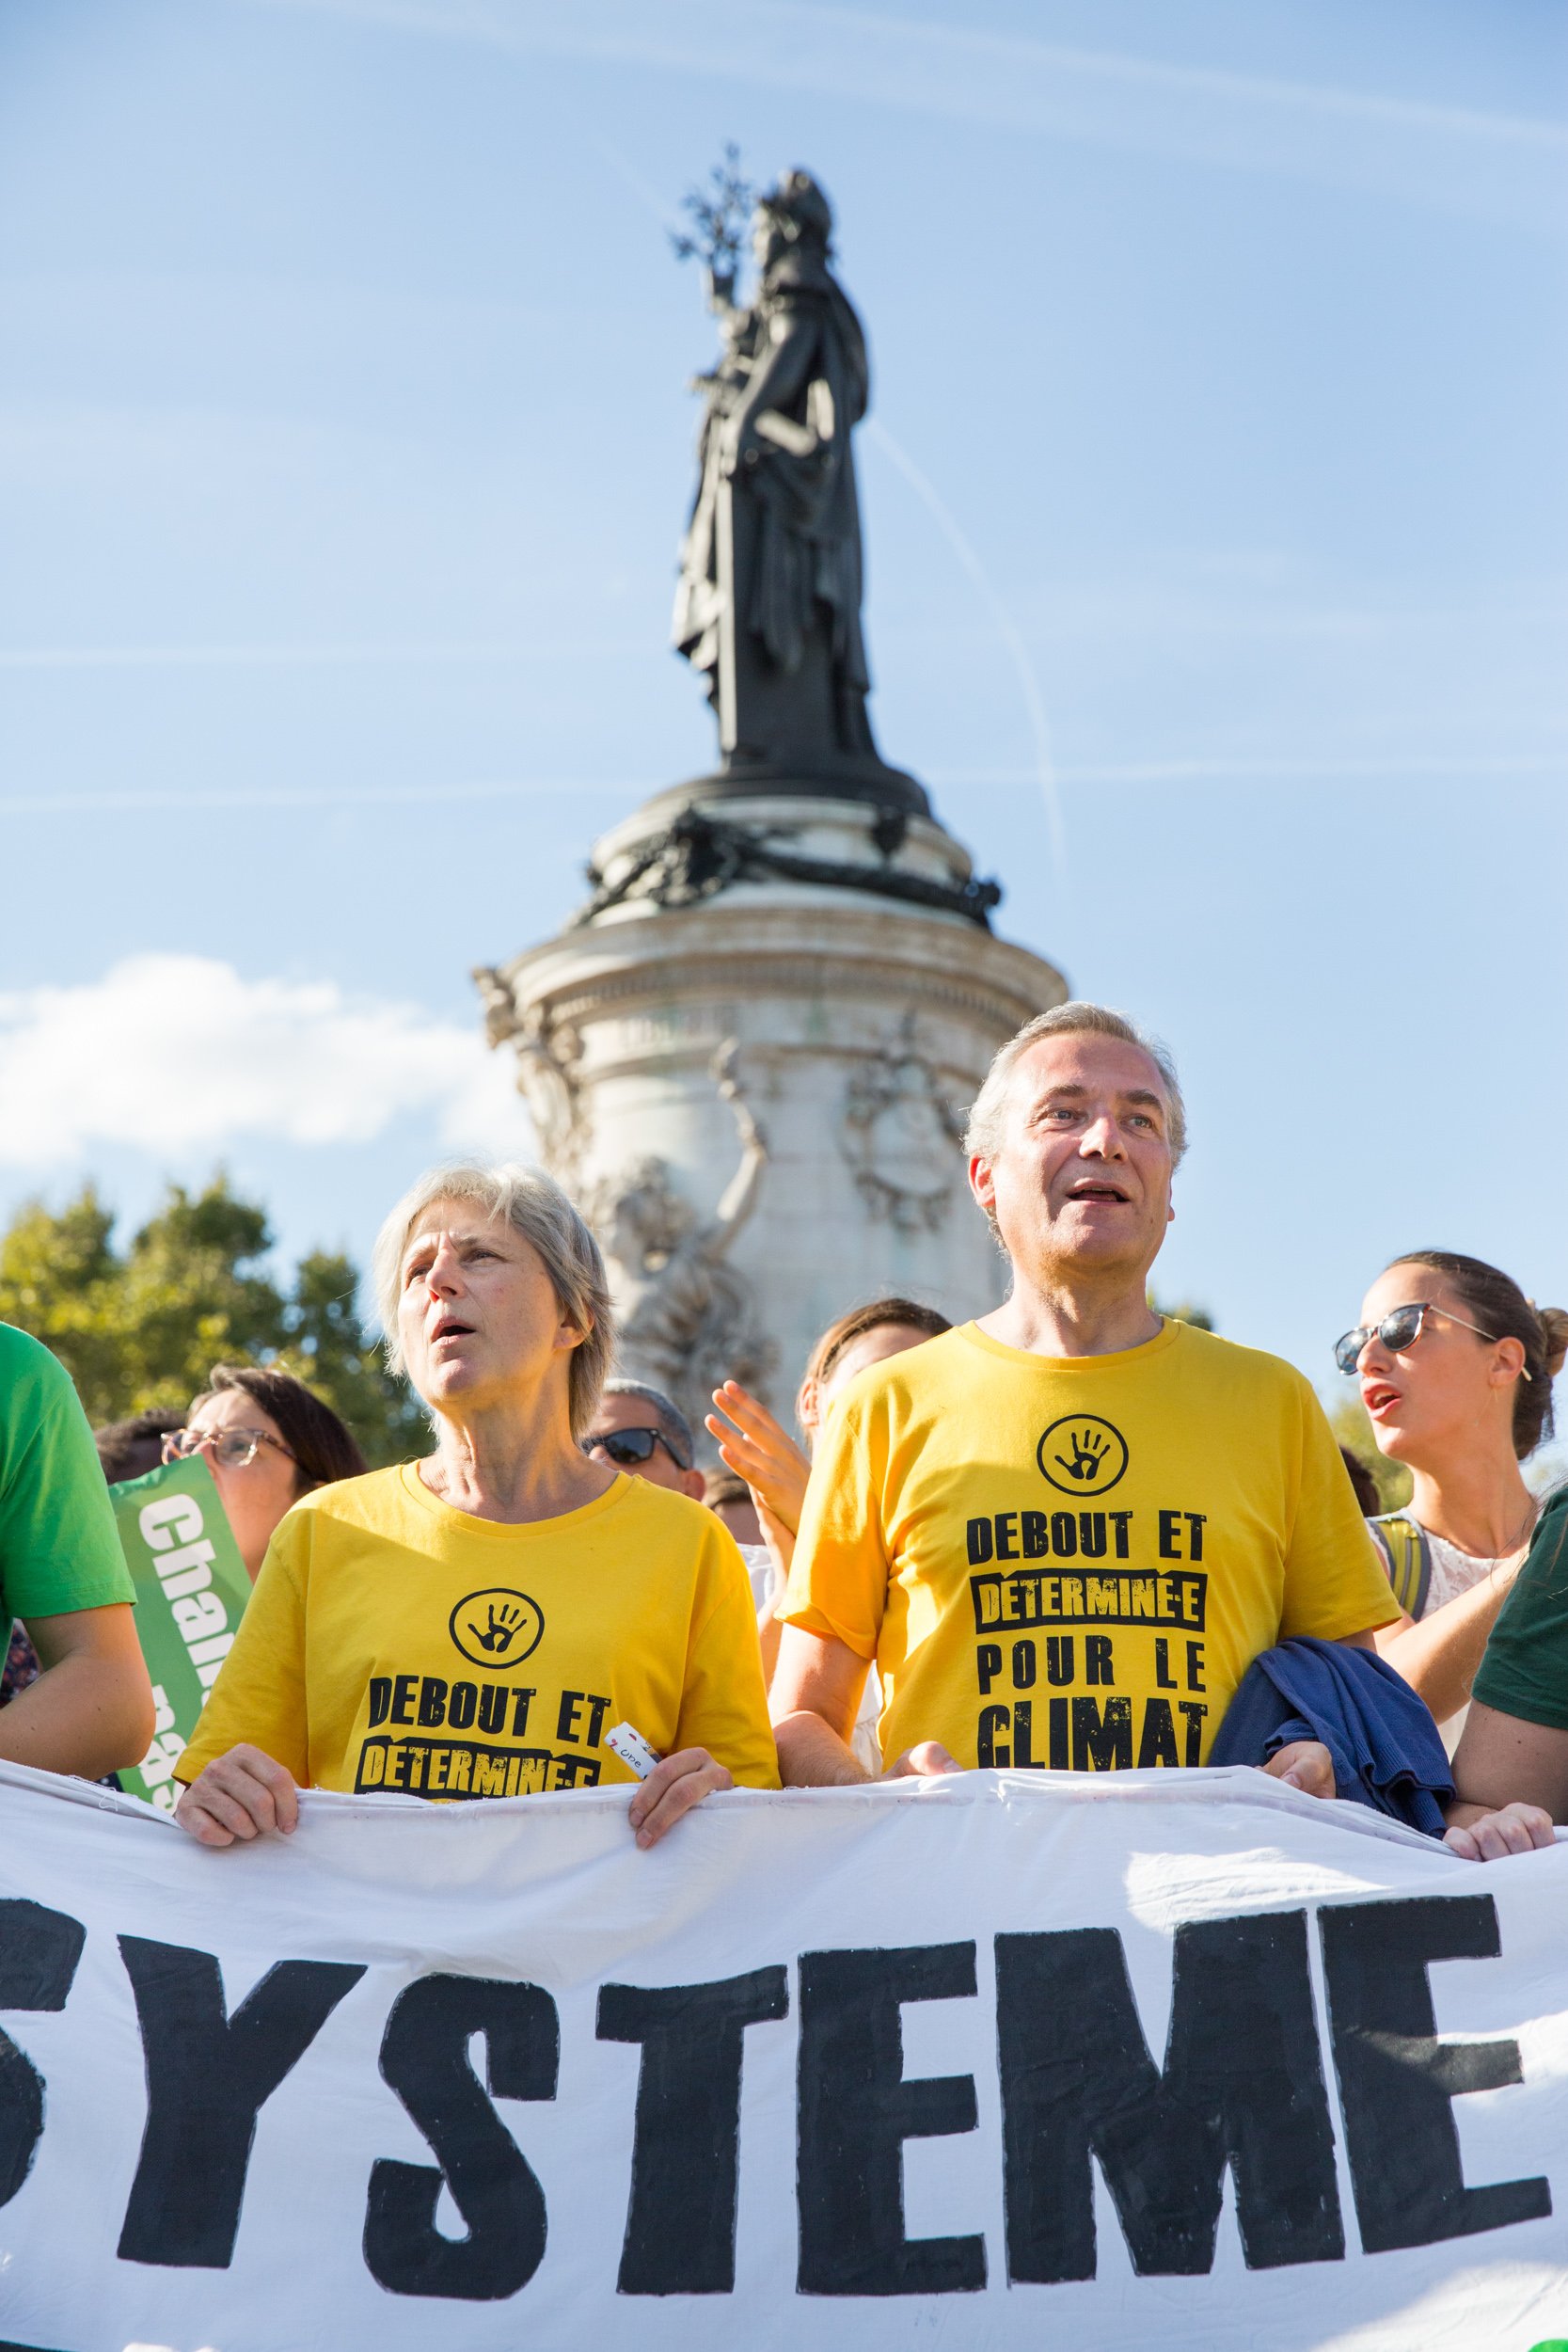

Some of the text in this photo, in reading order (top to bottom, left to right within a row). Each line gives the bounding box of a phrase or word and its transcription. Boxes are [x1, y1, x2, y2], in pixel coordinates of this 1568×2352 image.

[967, 1510, 1207, 1565] DEBOUT ET
[138, 1493, 235, 1708] Chan
[977, 1635, 1207, 1695] POUR LE
[368, 1675, 611, 1748] DEBOUT ET
[977, 1696, 1208, 1772] CLIMAT
